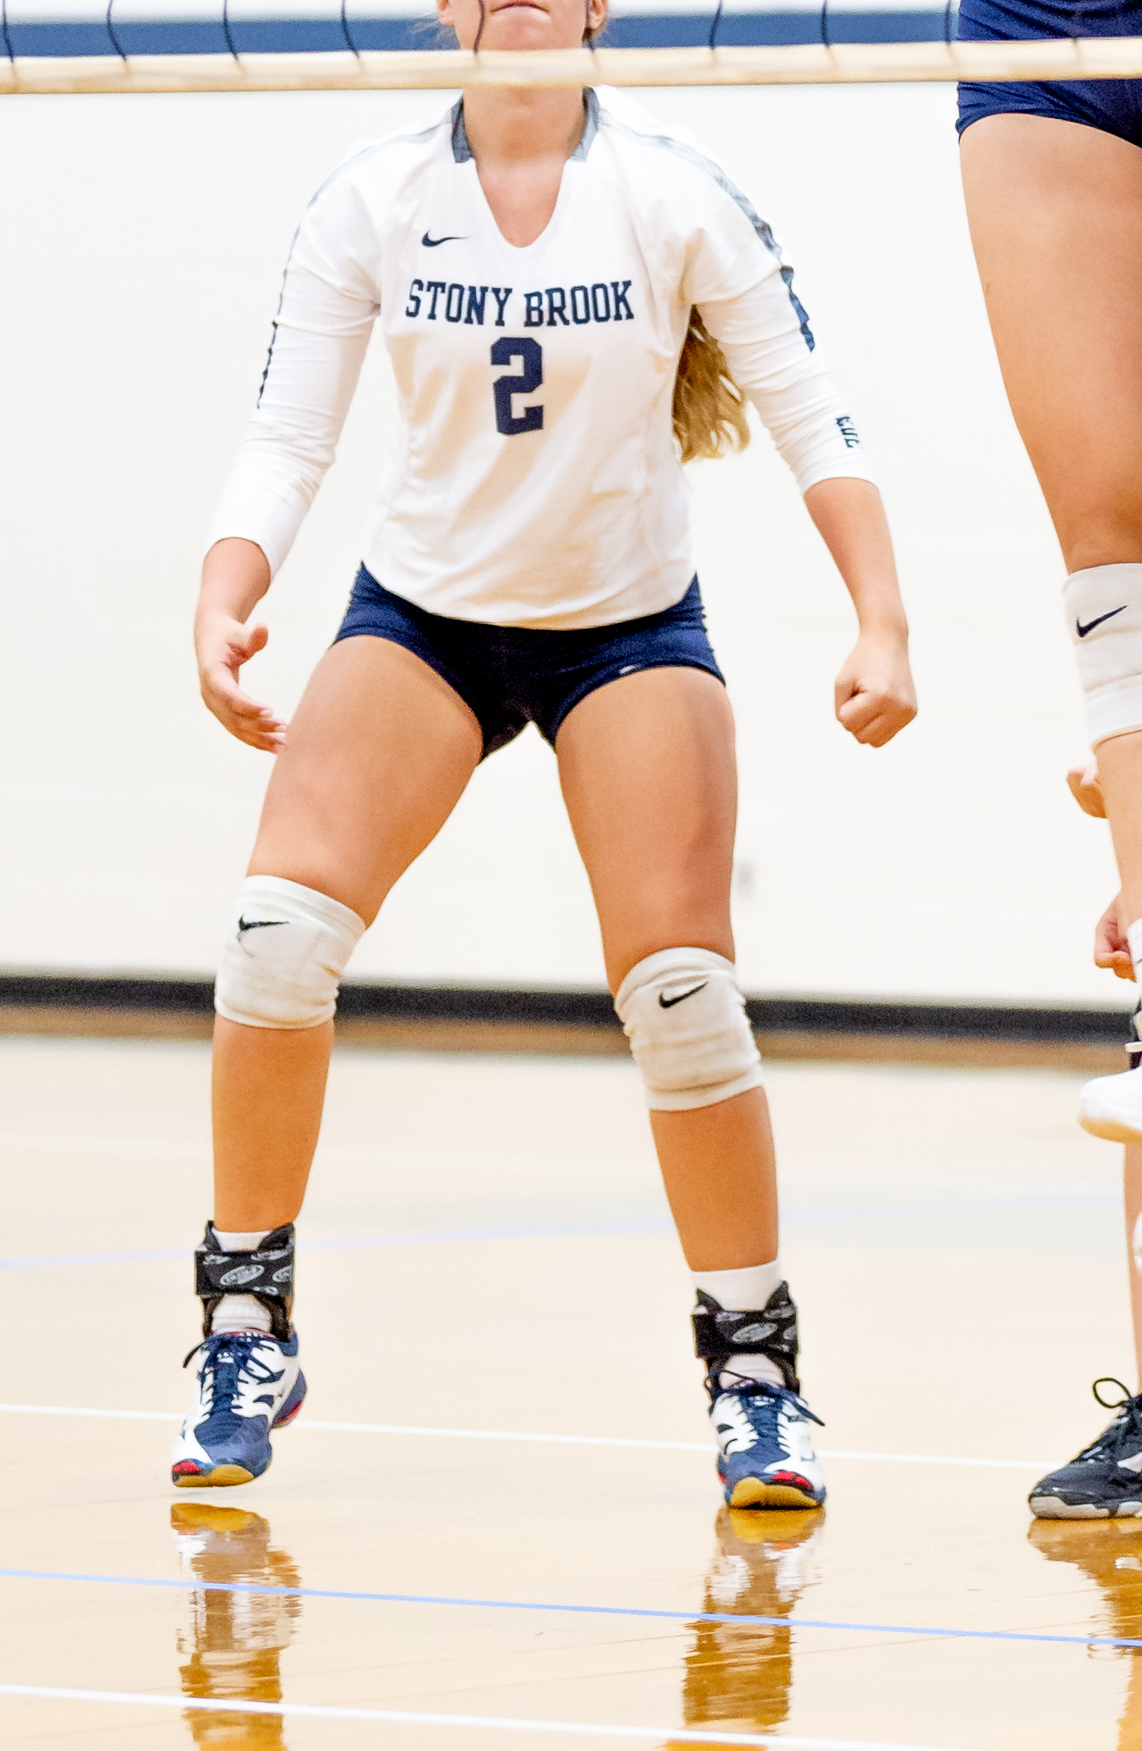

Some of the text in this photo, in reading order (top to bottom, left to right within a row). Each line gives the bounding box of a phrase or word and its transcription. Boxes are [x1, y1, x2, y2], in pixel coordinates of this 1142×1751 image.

[405, 278, 634, 327] STONY BROOK
[490, 337, 544, 436] 2
